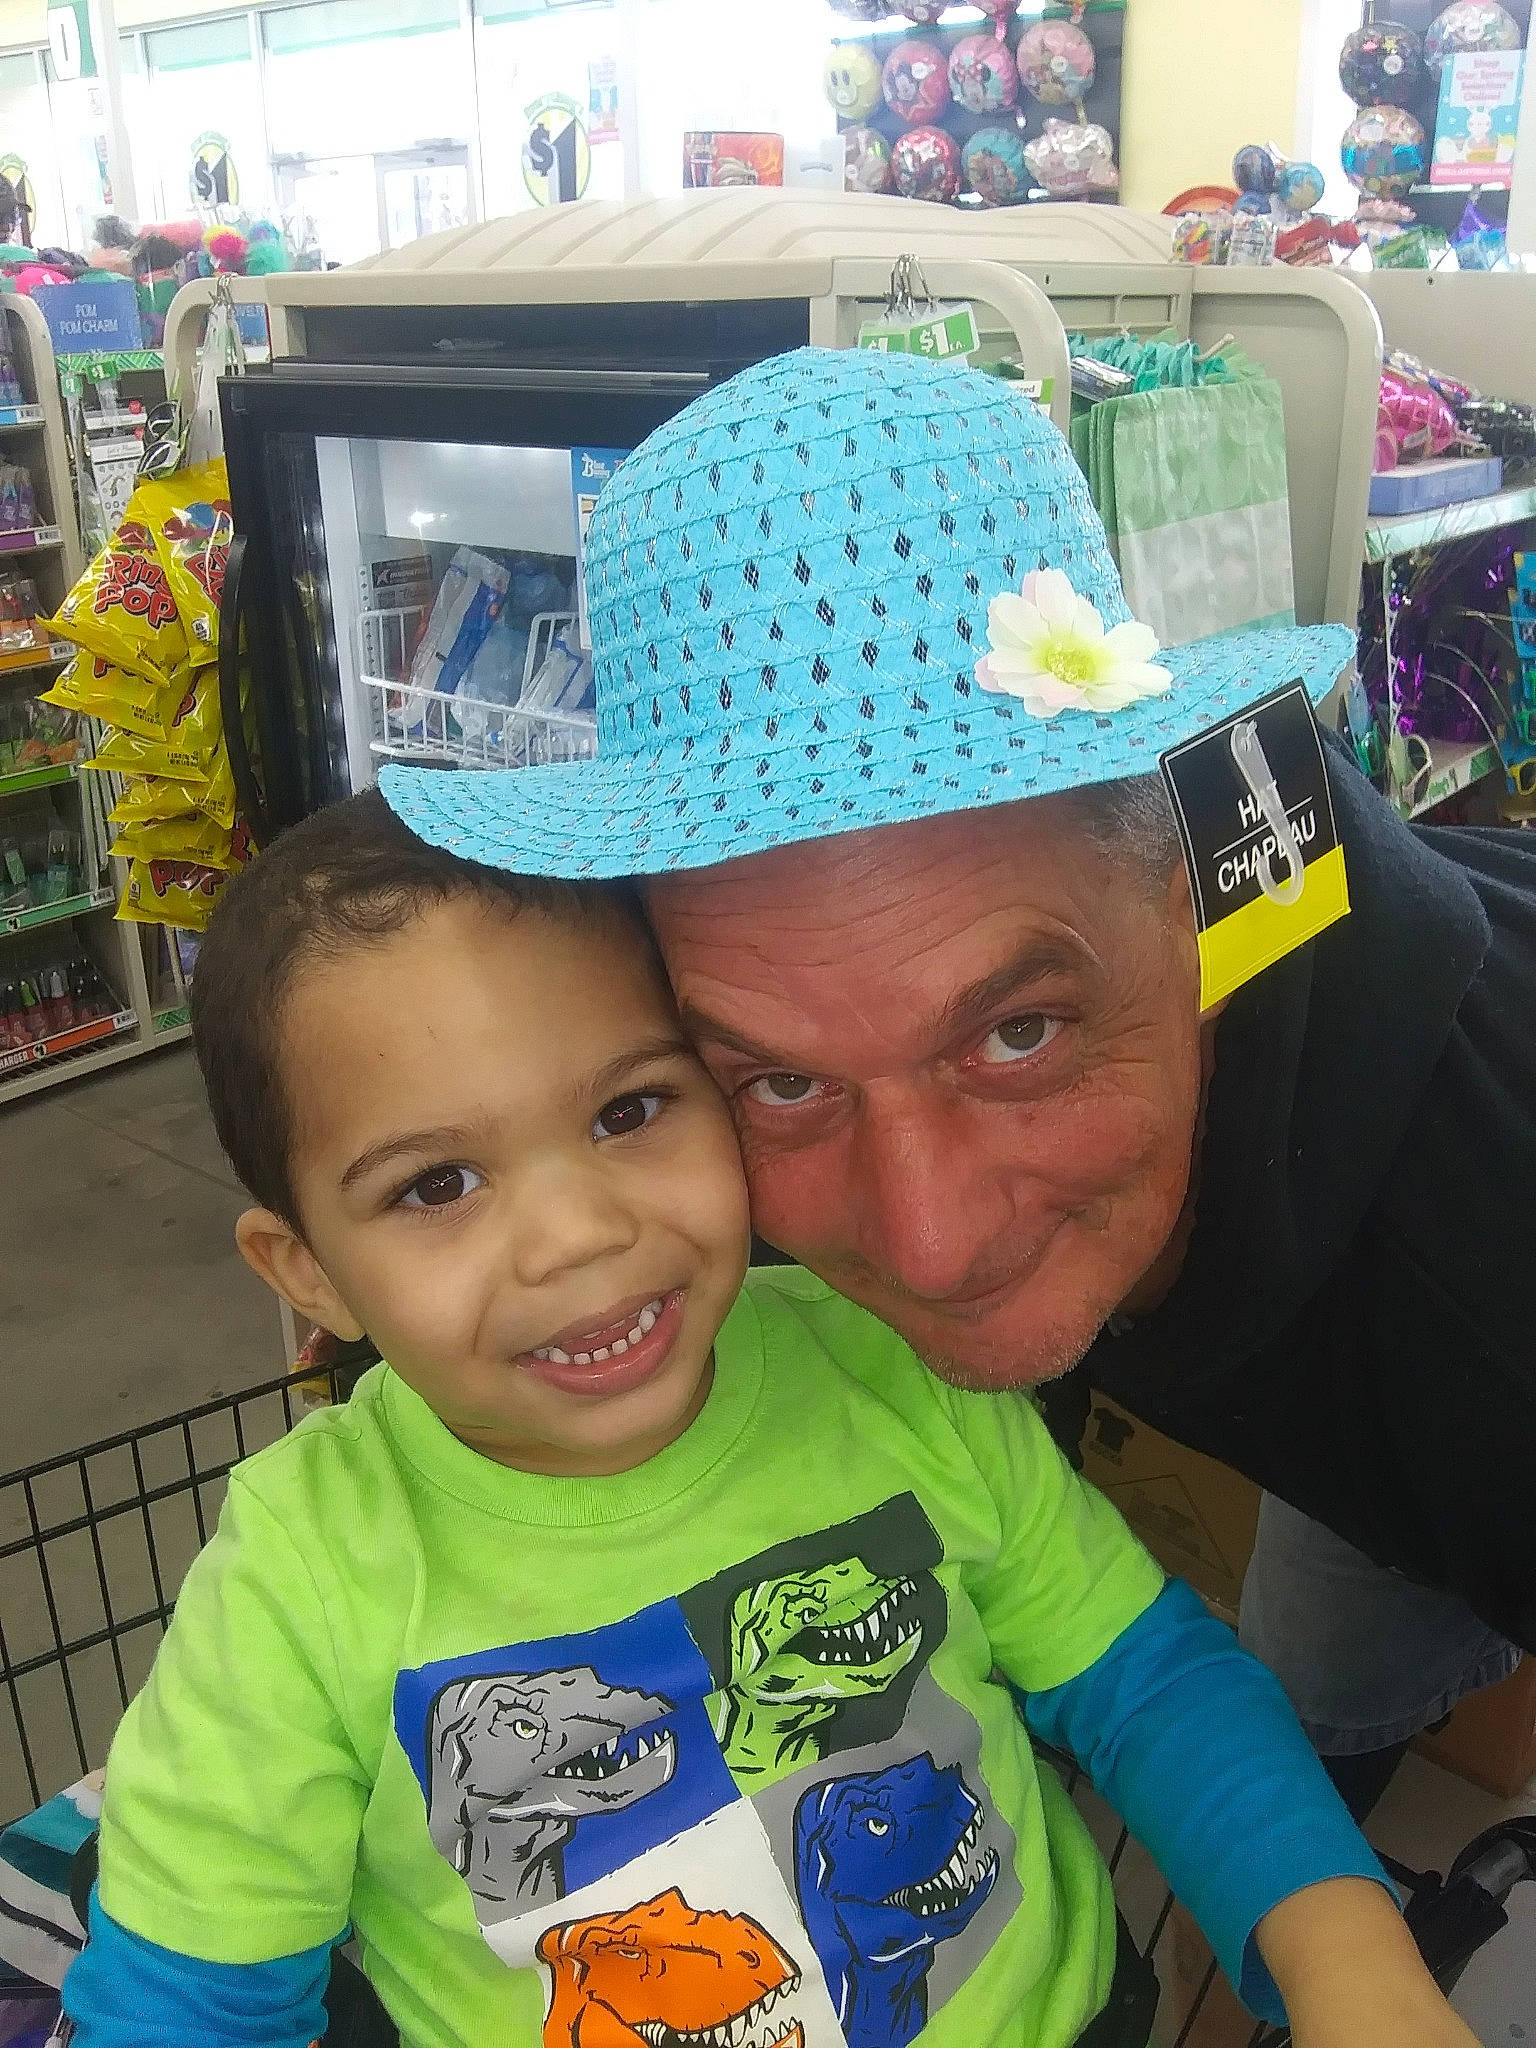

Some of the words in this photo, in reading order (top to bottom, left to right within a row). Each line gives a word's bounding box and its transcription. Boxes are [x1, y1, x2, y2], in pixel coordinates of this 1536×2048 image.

[191, 152, 229, 204] $1
[522, 119, 577, 203] $1
[75, 303, 97, 318] POM
[919, 321, 949, 356] $1
